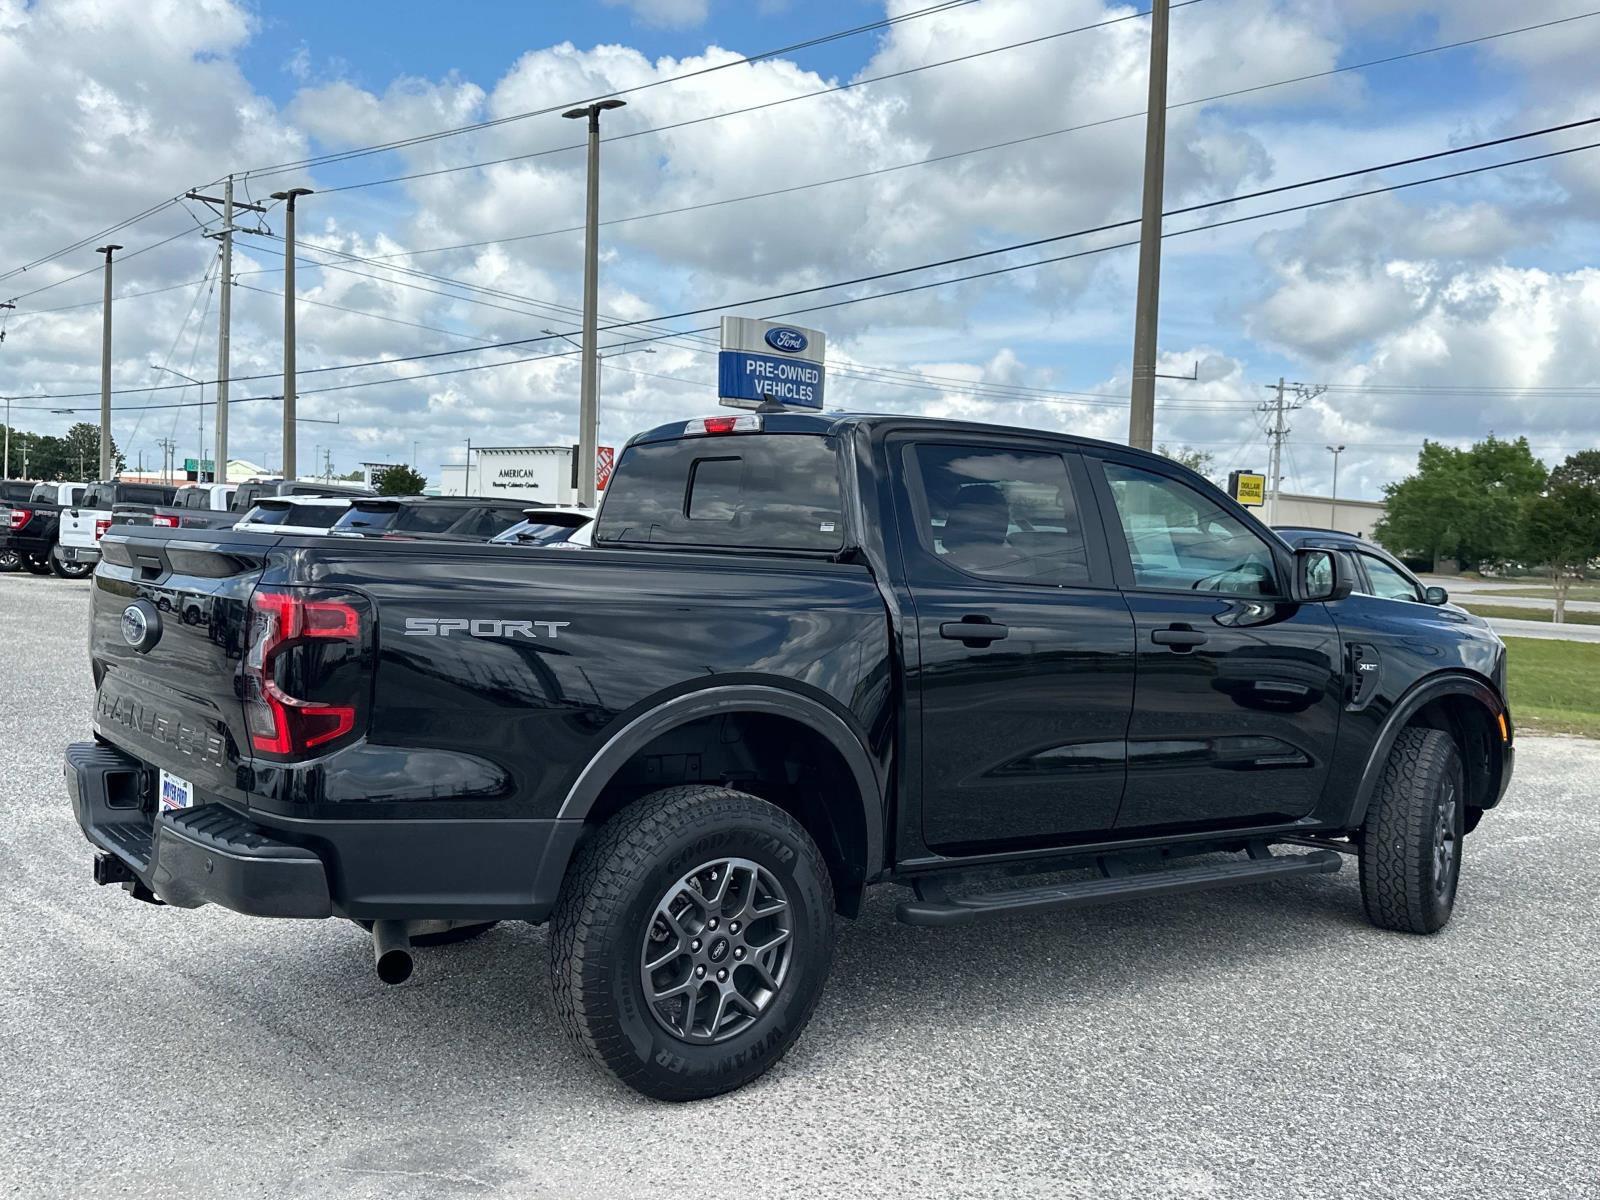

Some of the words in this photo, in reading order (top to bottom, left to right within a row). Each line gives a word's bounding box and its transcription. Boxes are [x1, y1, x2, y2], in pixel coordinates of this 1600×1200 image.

[776, 331, 801, 349] Ford
[746, 360, 819, 384] PRE-OWNED
[754, 379, 813, 401] VEHICLES
[498, 469, 534, 478] AMERICAN
[1239, 489, 1261, 498] GENERAL
[1240, 482, 1261, 490] DOLLAR
[404, 617, 571, 638] SPORT
[97, 688, 226, 768] RANGER
